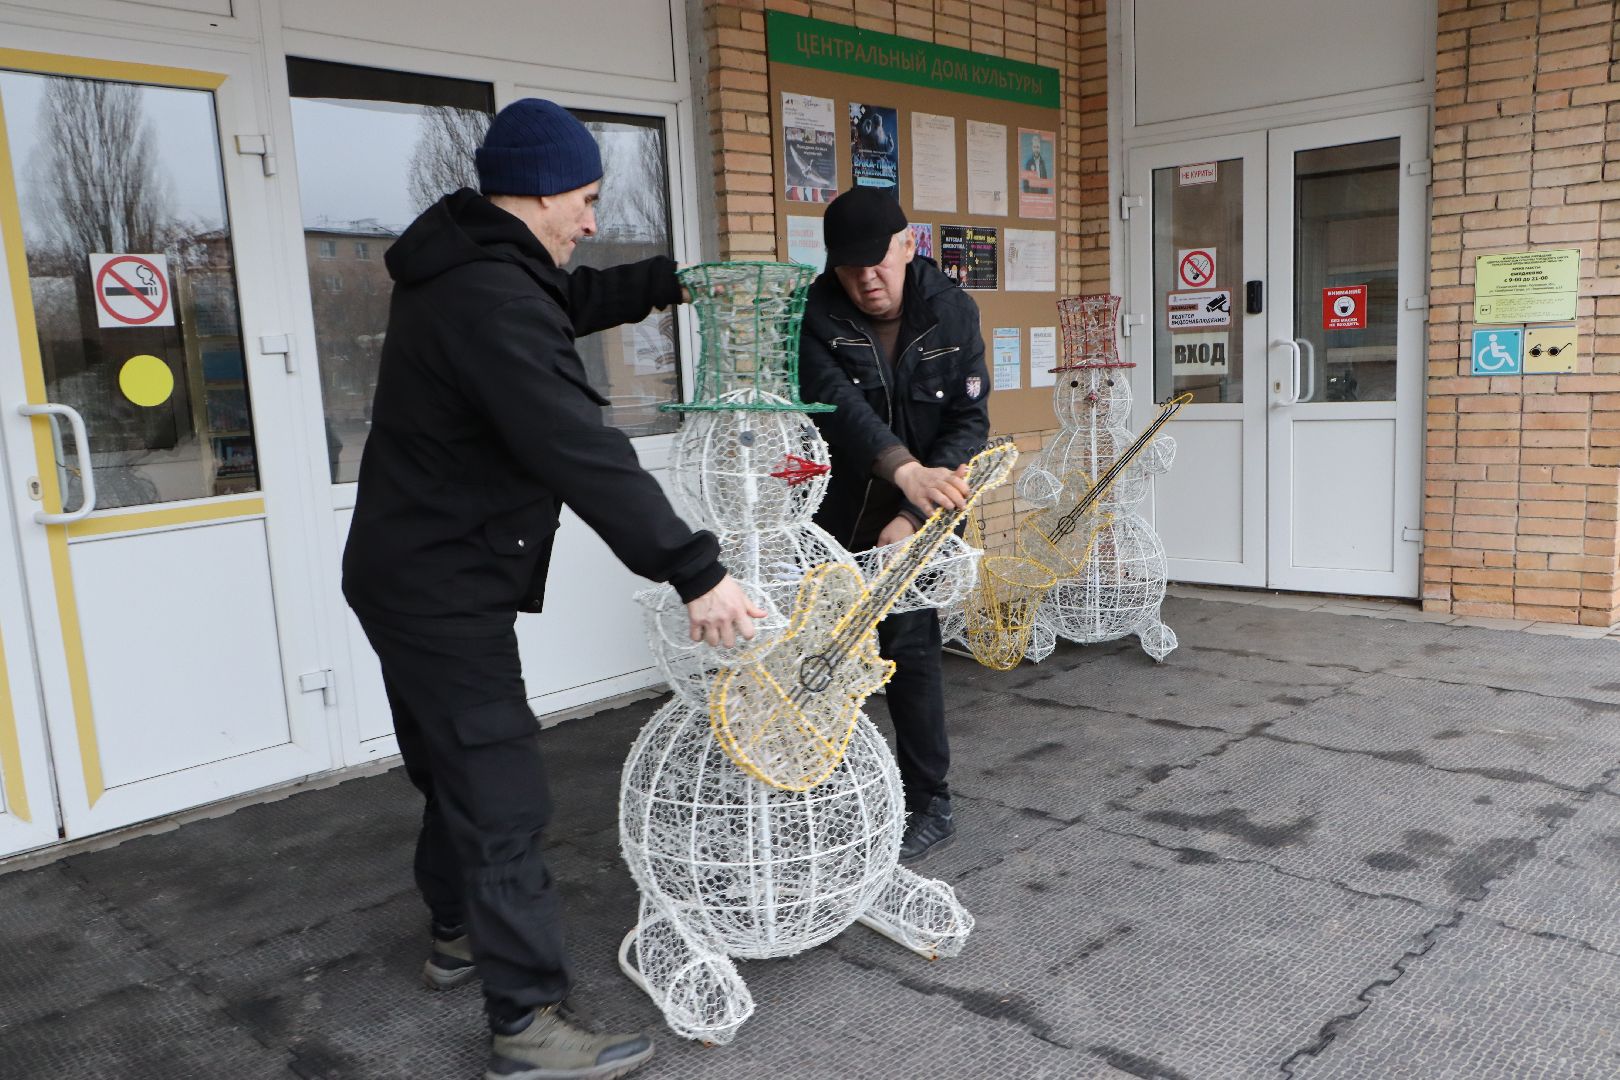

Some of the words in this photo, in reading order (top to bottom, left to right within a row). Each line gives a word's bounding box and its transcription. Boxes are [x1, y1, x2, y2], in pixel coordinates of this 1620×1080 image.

[795, 31, 927, 74] ЦЕНТРАЛЬНЫЙ
[931, 58, 969, 82] ДОМ
[972, 63, 1043, 95] КУЛЬТУРЫ
[1327, 288, 1362, 296] ВНИМАНИЕ
[1174, 342, 1226, 366] ВХОД
